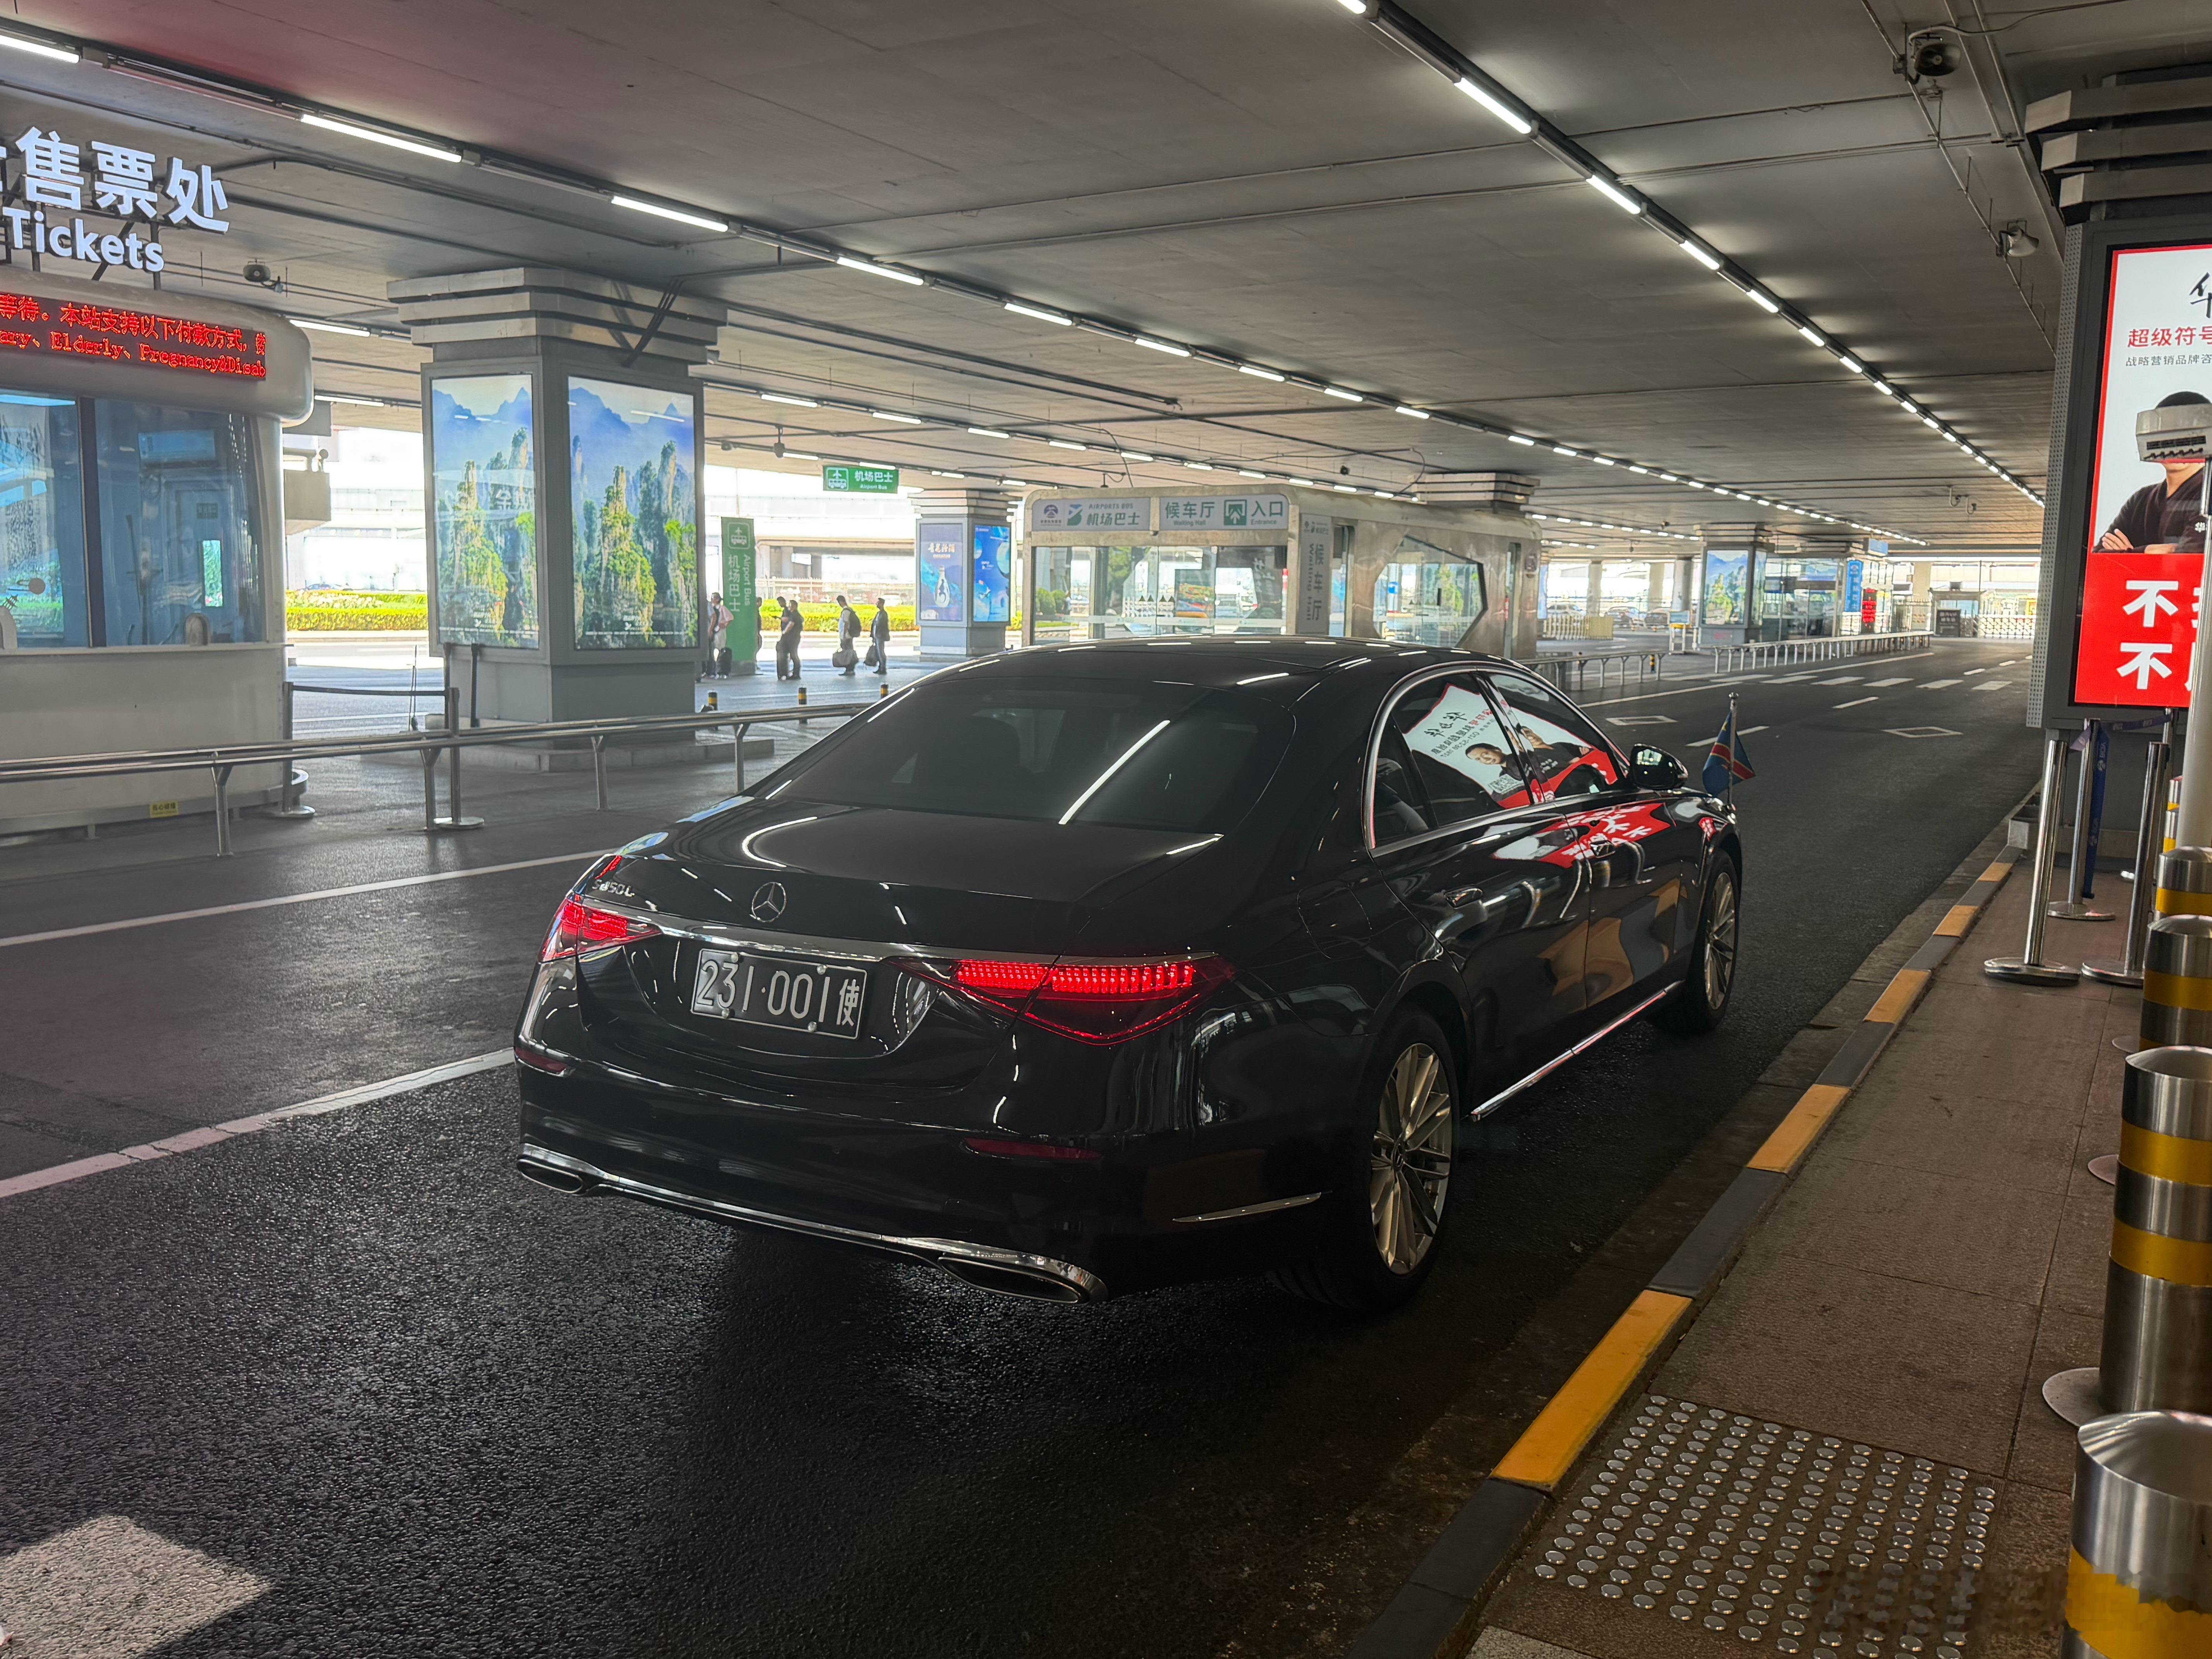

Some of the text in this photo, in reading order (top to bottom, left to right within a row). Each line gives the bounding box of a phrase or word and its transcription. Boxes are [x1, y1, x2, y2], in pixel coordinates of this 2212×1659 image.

[0, 126, 230, 234] 售票处
[3, 207, 165, 272] Tickets
[855, 470, 893, 483] 机场巴士
[1086, 512, 1140, 526] 机场巴士
[1165, 501, 1215, 519] 候车厅
[1251, 500, 1283, 517] 入口
[728, 554, 741, 611] 机场巴士
[742, 554, 751, 586] Airport
